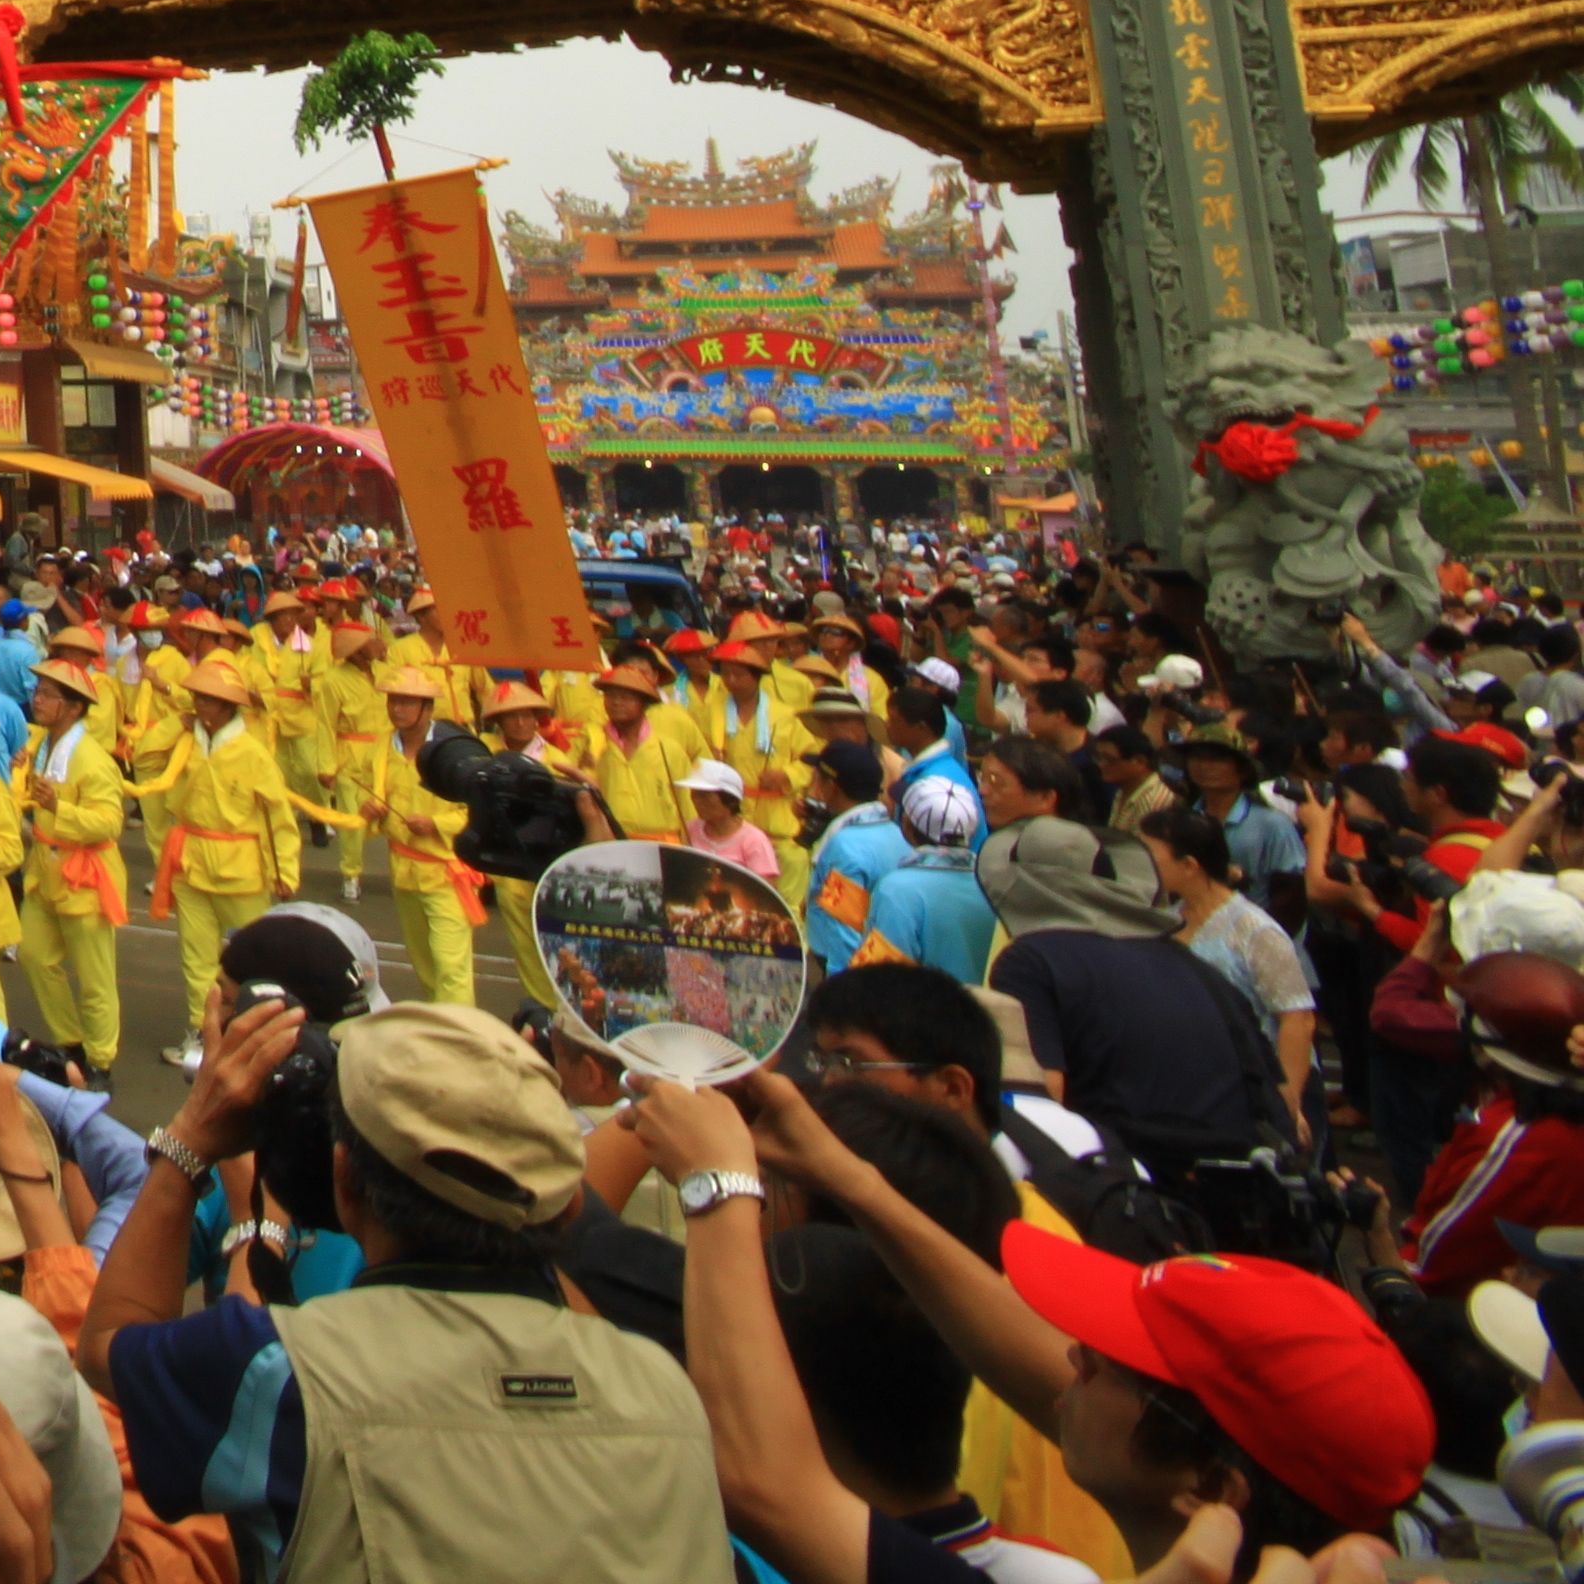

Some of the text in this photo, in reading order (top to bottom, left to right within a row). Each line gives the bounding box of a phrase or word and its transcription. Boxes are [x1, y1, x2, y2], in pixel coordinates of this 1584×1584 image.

[697, 333, 817, 367] 代天府
[380, 364, 523, 408] 代天巡狩
[452, 457, 532, 532] 羅
